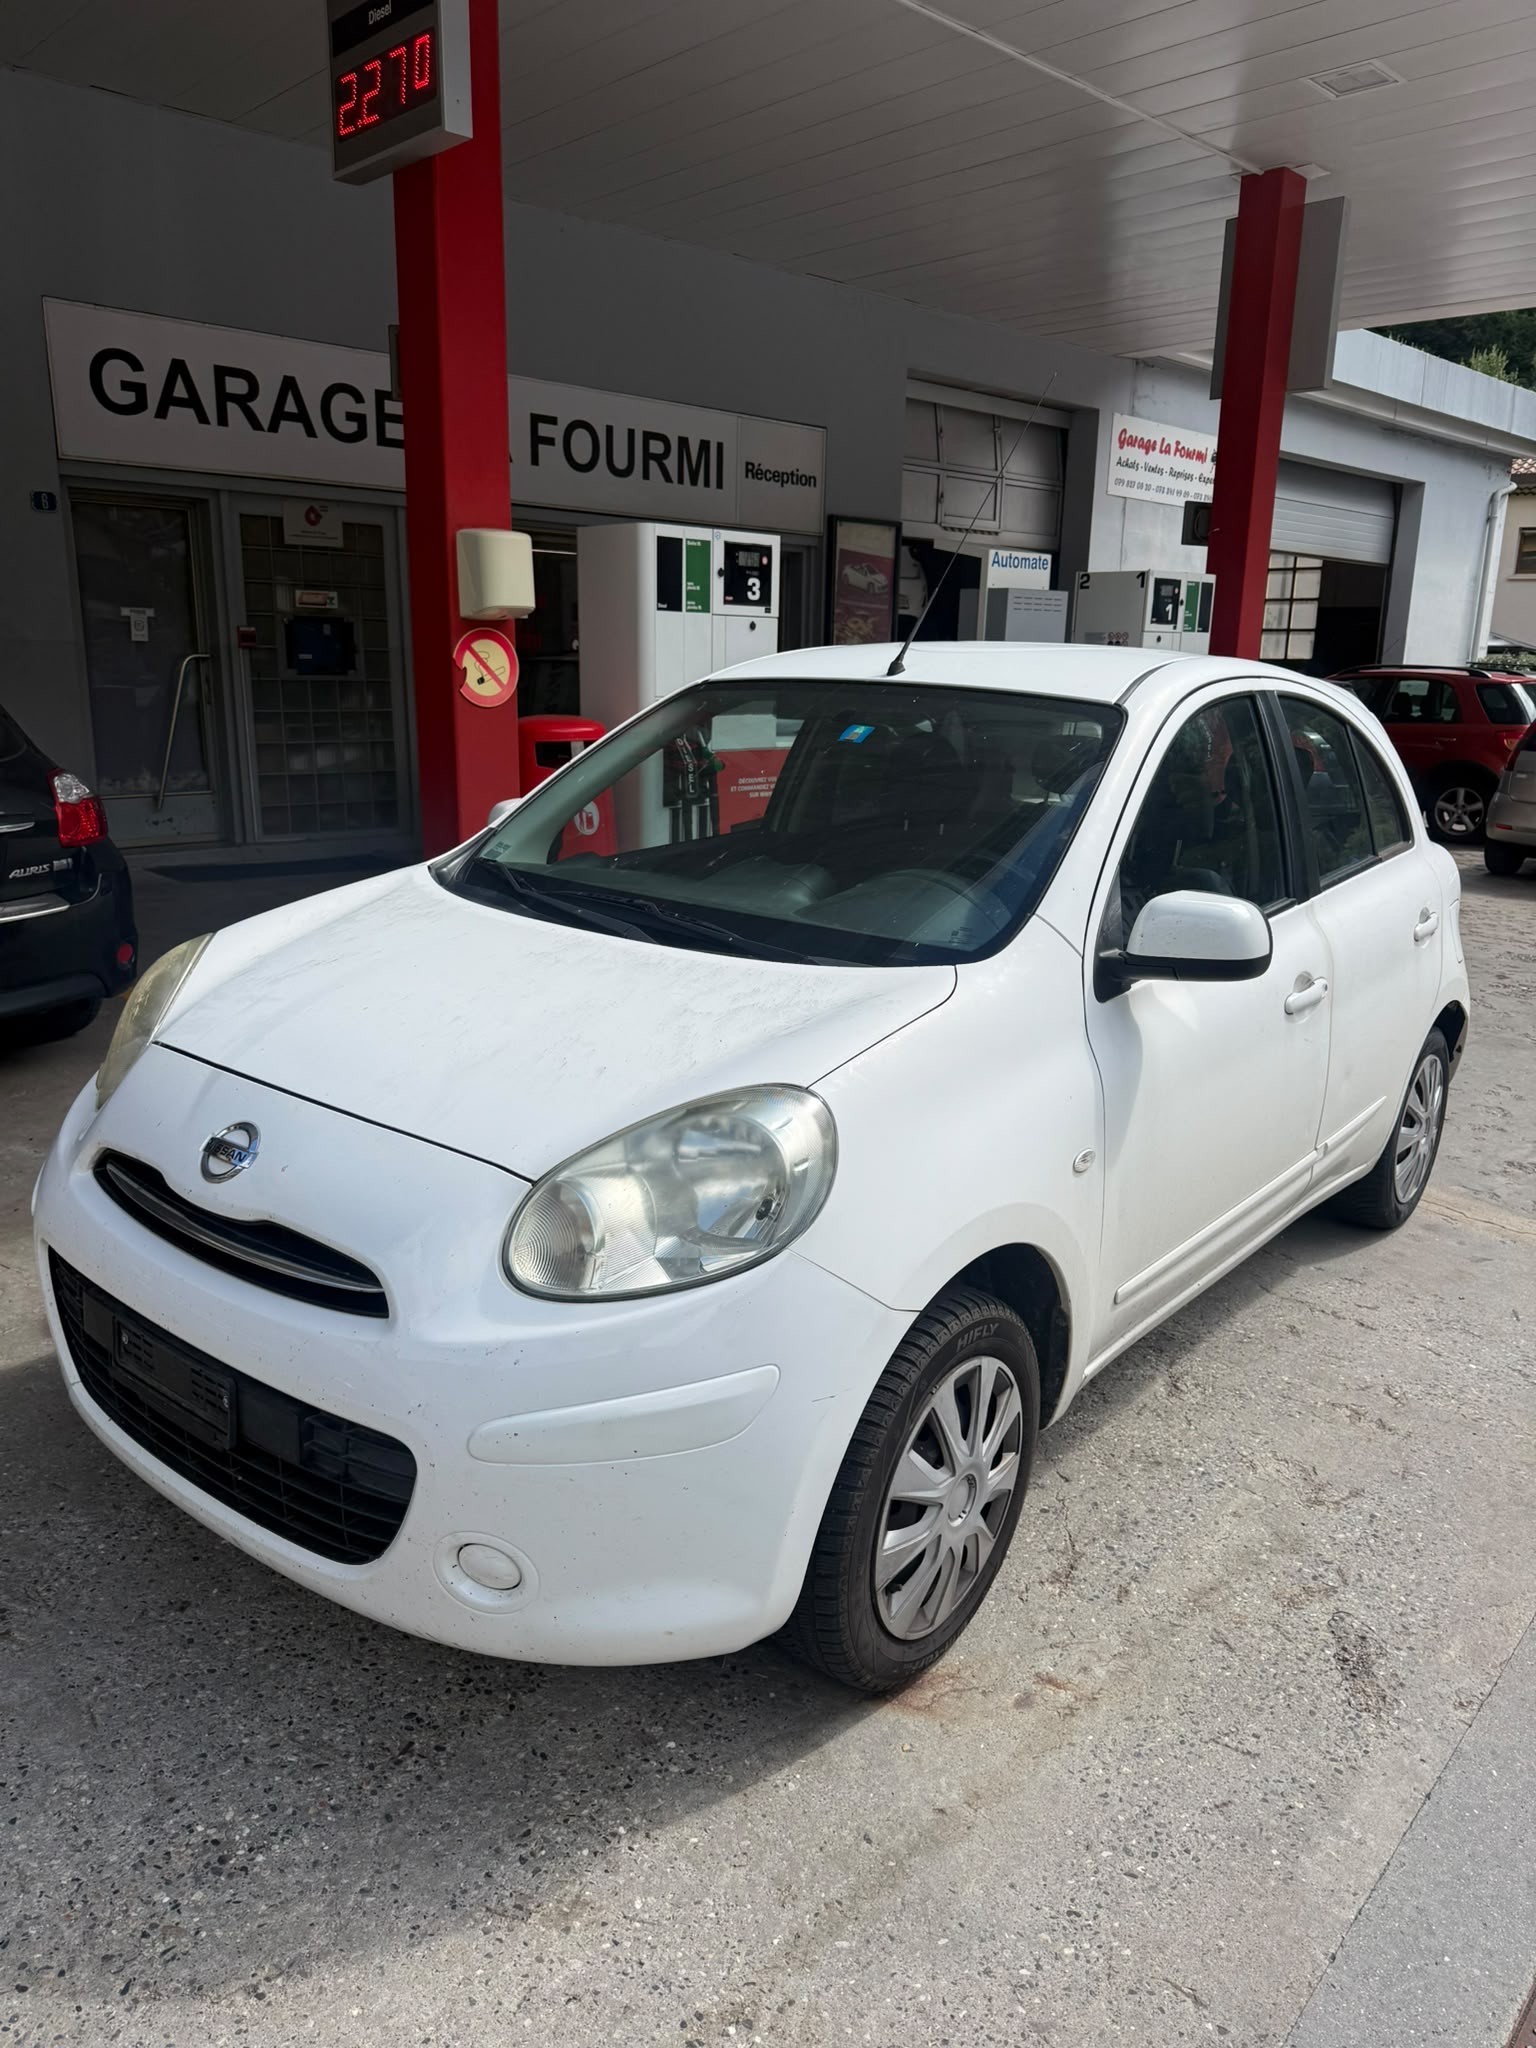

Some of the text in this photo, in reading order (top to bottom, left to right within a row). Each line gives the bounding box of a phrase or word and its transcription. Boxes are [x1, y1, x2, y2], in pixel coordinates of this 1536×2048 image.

[368, 0, 392, 25] Diesel
[89, 348, 724, 490] GARAGE FOURMI
[1118, 428, 1208, 464] Garage La Fourmi
[744, 461, 817, 489] Réception
[1116, 456, 1139, 472] Achats
[1144, 462, 1164, 476] Ventes
[1169, 467, 1194, 482] Reprises
[991, 551, 1049, 570] Automate
[747, 577, 761, 601] 3
[1080, 573, 1091, 590] 2
[1136, 571, 1146, 588] 1
[1165, 604, 1173, 621] 1
[9, 863, 51, 879] AURIS
[957, 1323, 999, 1352] HIFLY
